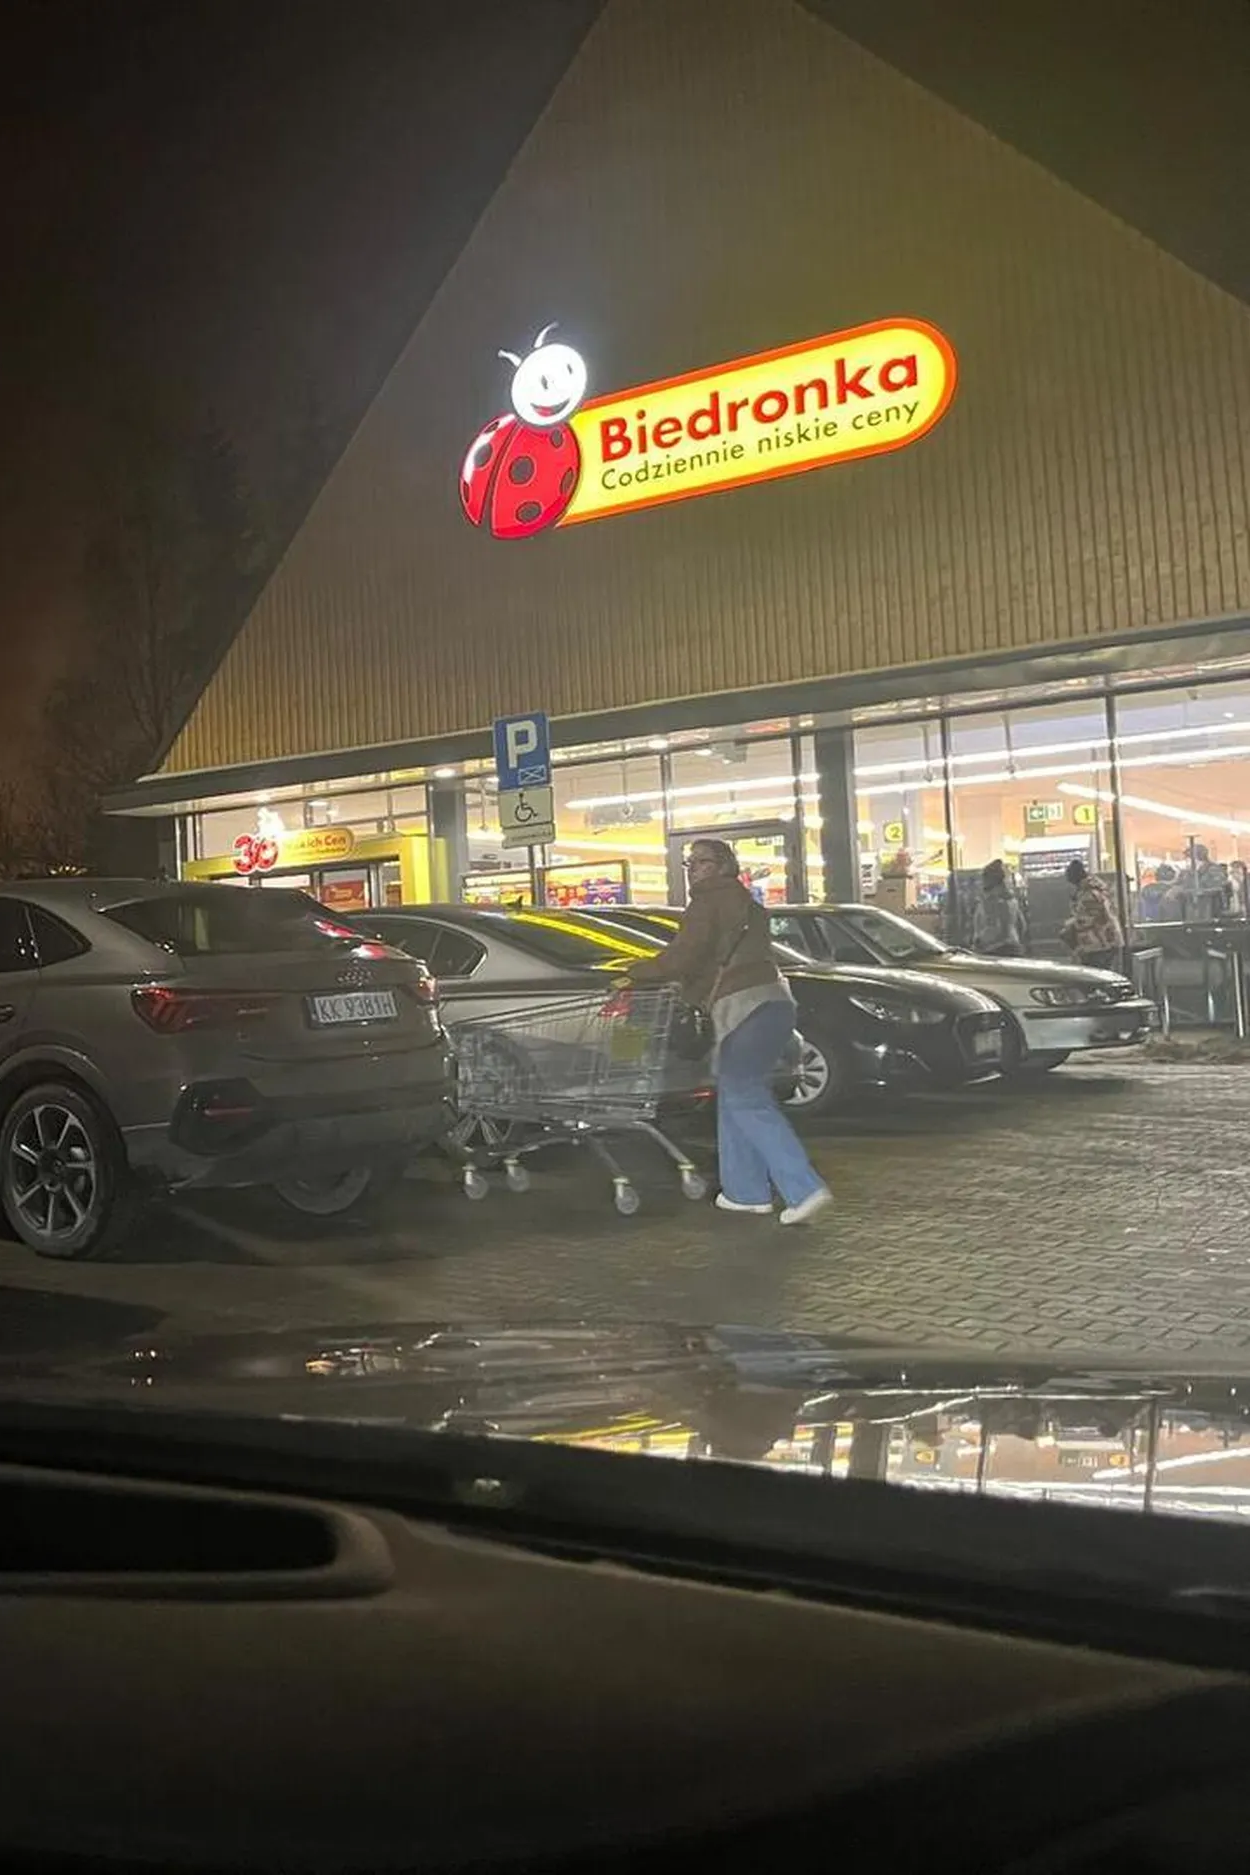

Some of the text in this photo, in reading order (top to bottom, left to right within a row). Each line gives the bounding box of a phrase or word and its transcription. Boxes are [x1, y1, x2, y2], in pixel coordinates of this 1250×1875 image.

[600, 354, 918, 463] Biedronka
[601, 401, 919, 490] Codziennie niskie ceny
[506, 720, 538, 769] P
[889, 826, 901, 838] 2
